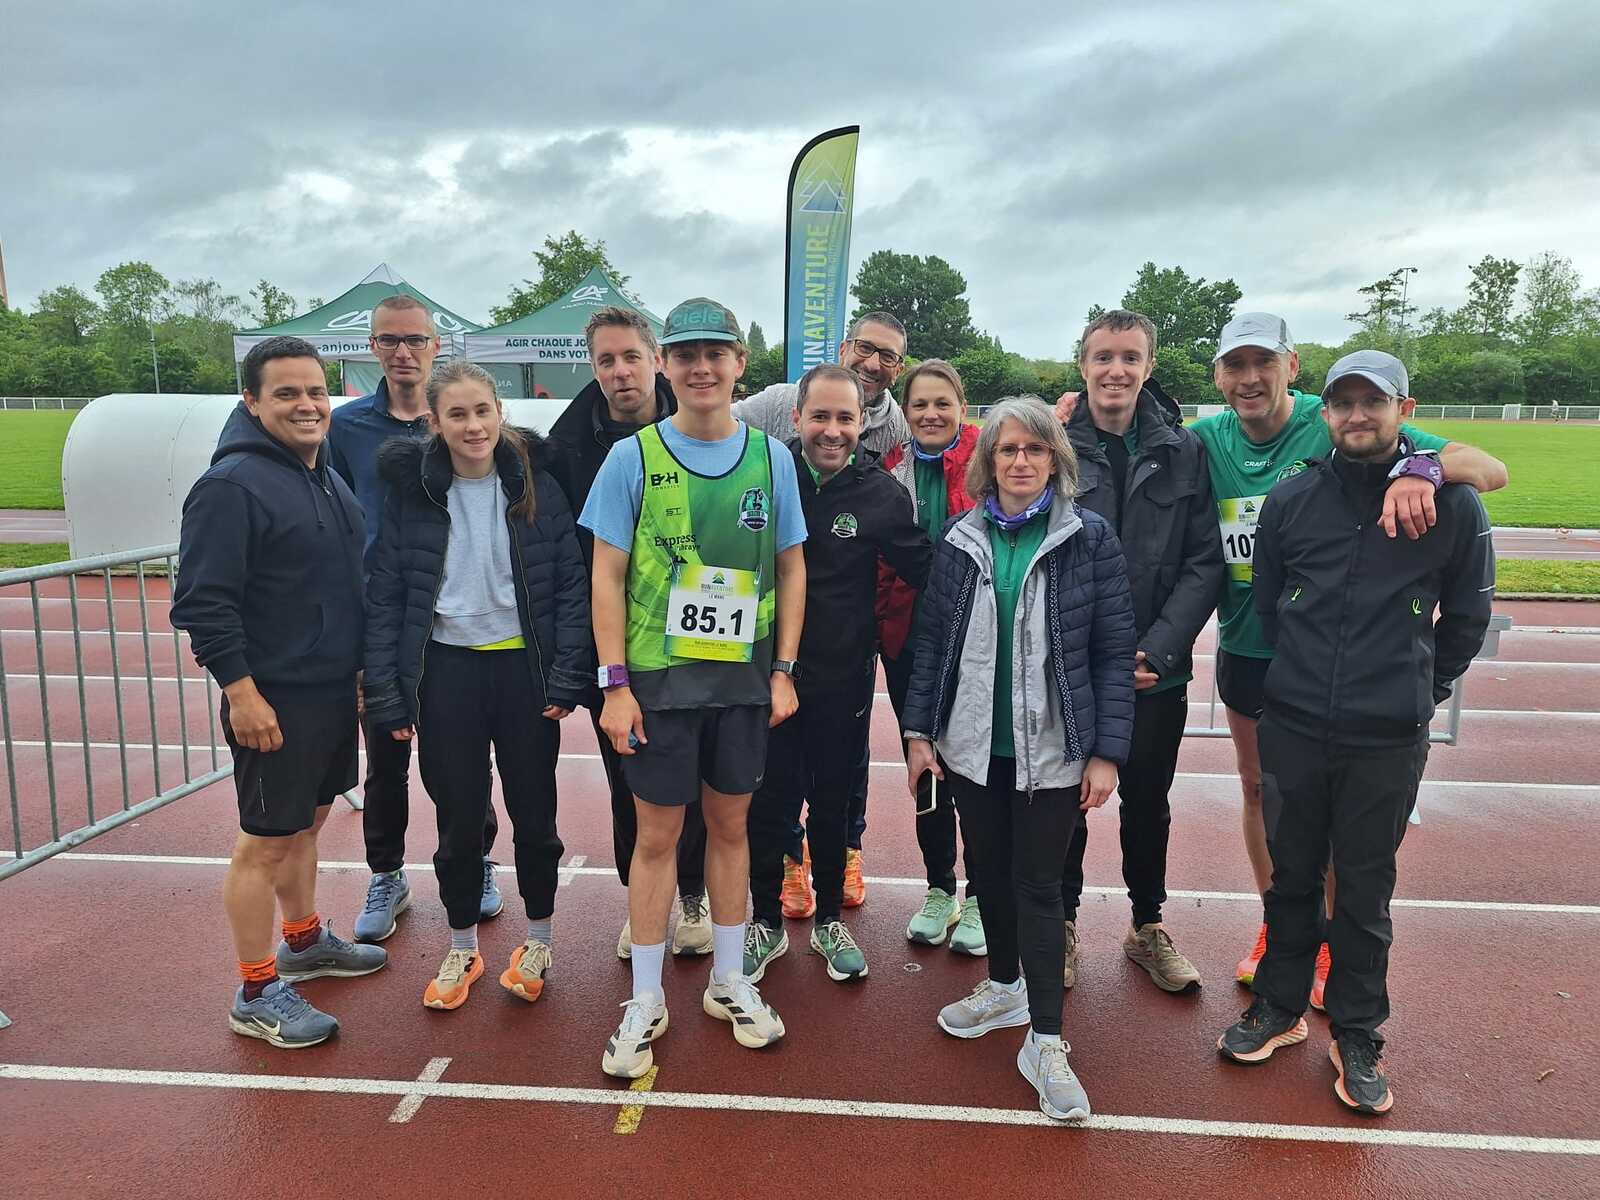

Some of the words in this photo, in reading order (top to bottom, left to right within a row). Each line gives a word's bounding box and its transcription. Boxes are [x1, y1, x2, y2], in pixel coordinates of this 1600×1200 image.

[802, 223, 830, 370] UNAVENTURE
[671, 308, 722, 327] ciele
[505, 338, 529, 348] AGIR
[531, 338, 573, 348] CHAQUE
[576, 338, 587, 348] JO
[538, 350, 567, 359] DANS
[568, 350, 589, 359] VOT
[654, 534, 697, 549] Express
[680, 603, 743, 636] 85.1
